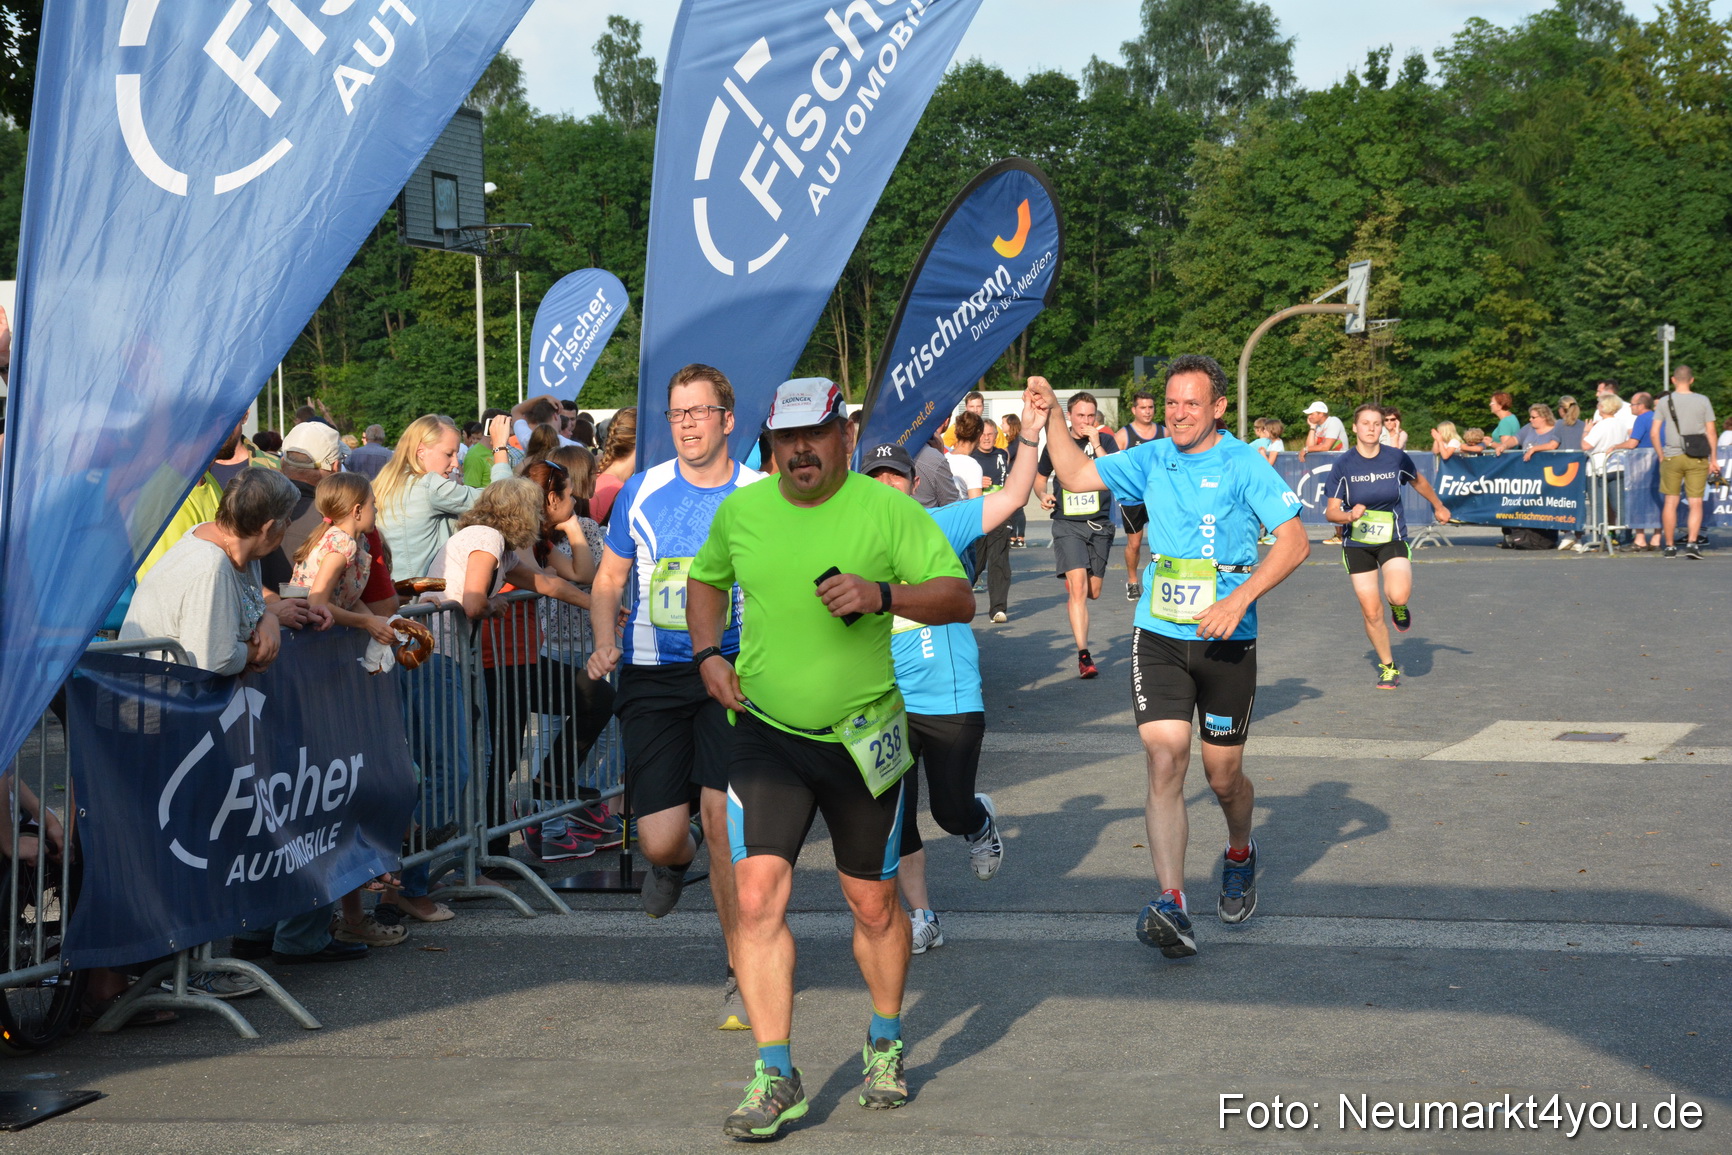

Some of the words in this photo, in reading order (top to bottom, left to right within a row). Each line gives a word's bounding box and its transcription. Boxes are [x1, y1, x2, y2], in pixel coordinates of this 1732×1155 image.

[203, 0, 357, 119] Fi
[739, 0, 898, 222] Fisch
[970, 306, 1000, 341] Druck
[1017, 251, 1053, 294] Medien
[552, 287, 606, 373] Fischer
[571, 303, 613, 371] AUTOMOBILE
[891, 264, 1012, 401] Frischmann
[1066, 494, 1096, 506] 1154
[1350, 474, 1371, 483] EURO
[1376, 471, 1396, 481] POLES
[1438, 474, 1543, 496] Frischmann
[1501, 496, 1523, 507] Druck
[1523, 496, 1544, 507] und
[1545, 498, 1577, 509] Medien
[1198, 513, 1216, 560] o.de
[1360, 521, 1385, 536] 347
[1161, 582, 1202, 605] 957
[869, 724, 902, 769] 238
[1209, 728, 1237, 738] sports
[209, 746, 364, 841] Fischer
[225, 821, 343, 887] AUTOMOBILE
